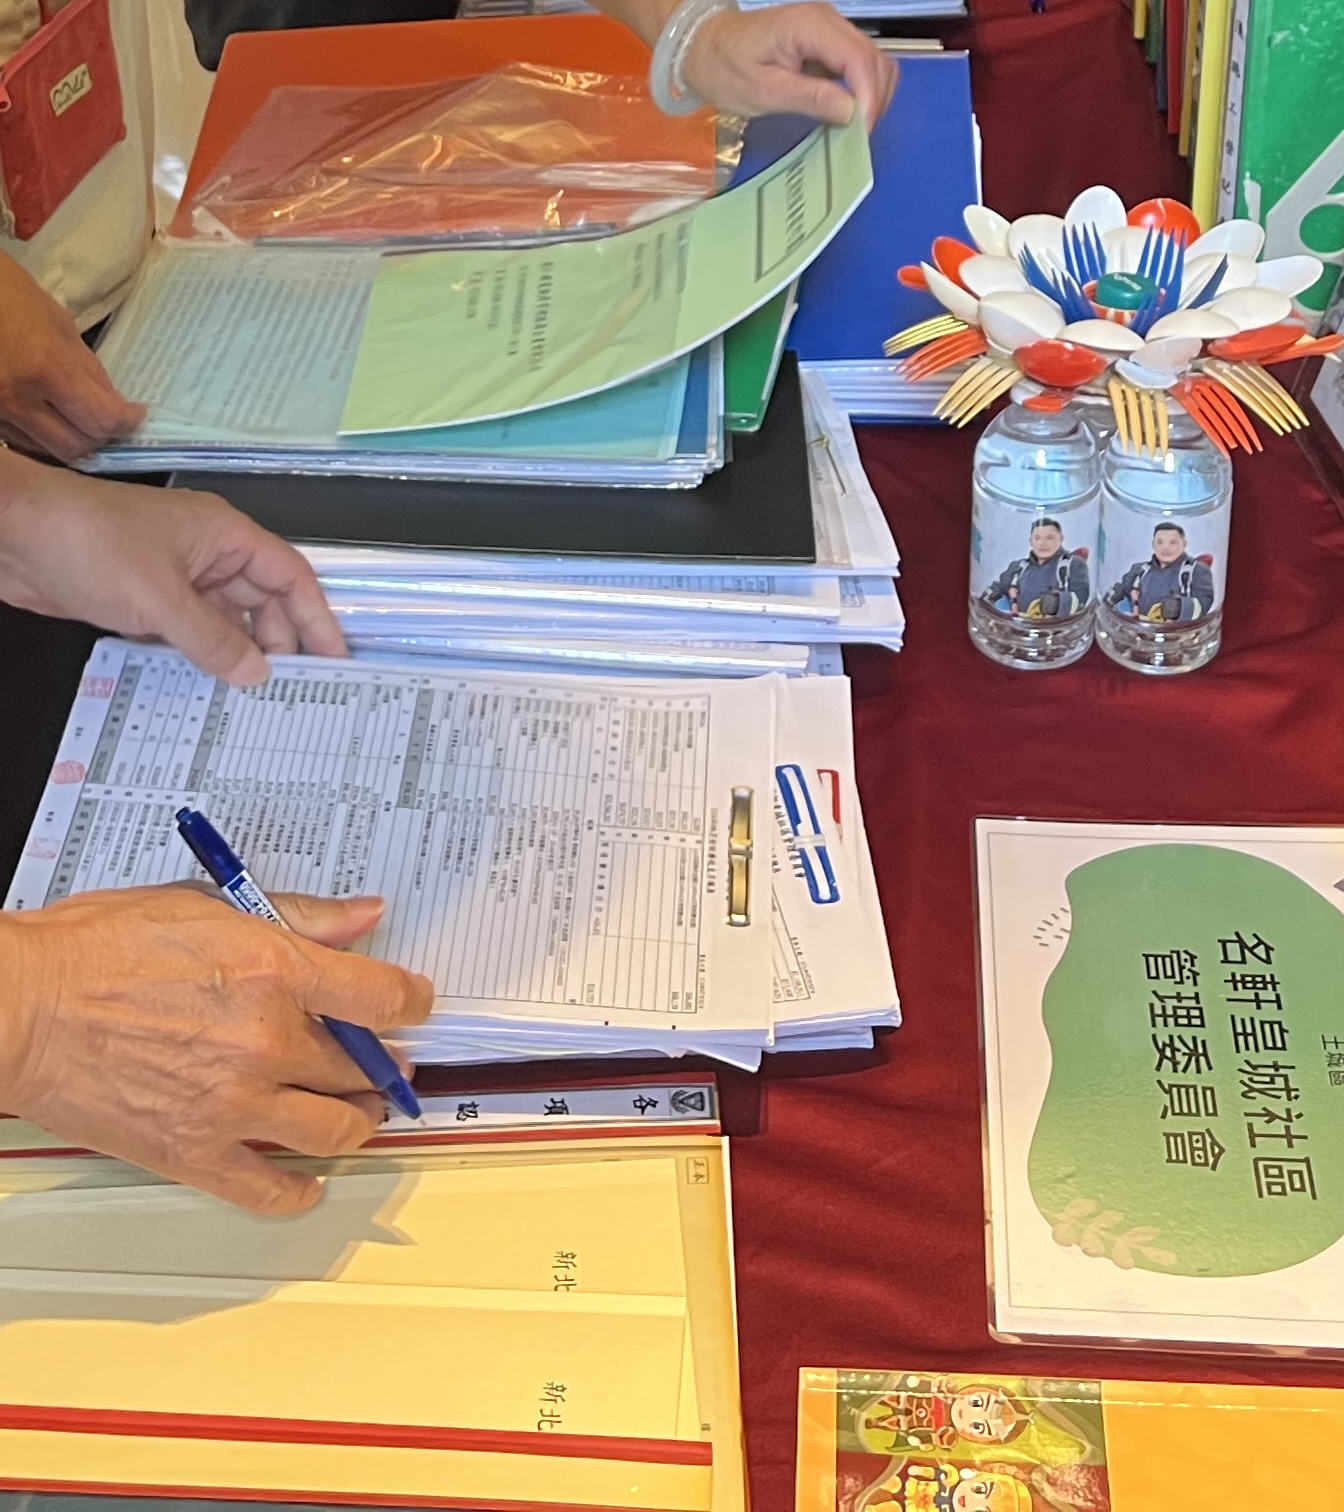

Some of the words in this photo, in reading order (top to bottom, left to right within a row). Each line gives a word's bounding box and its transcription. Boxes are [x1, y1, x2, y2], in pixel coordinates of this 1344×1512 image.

[383, 1093, 660, 1122] 各項認
[1141, 948, 1227, 1174] 管理委員會
[1216, 931, 1318, 1202] 名軒皇城社區
[536, 1382, 567, 1432] 新北
